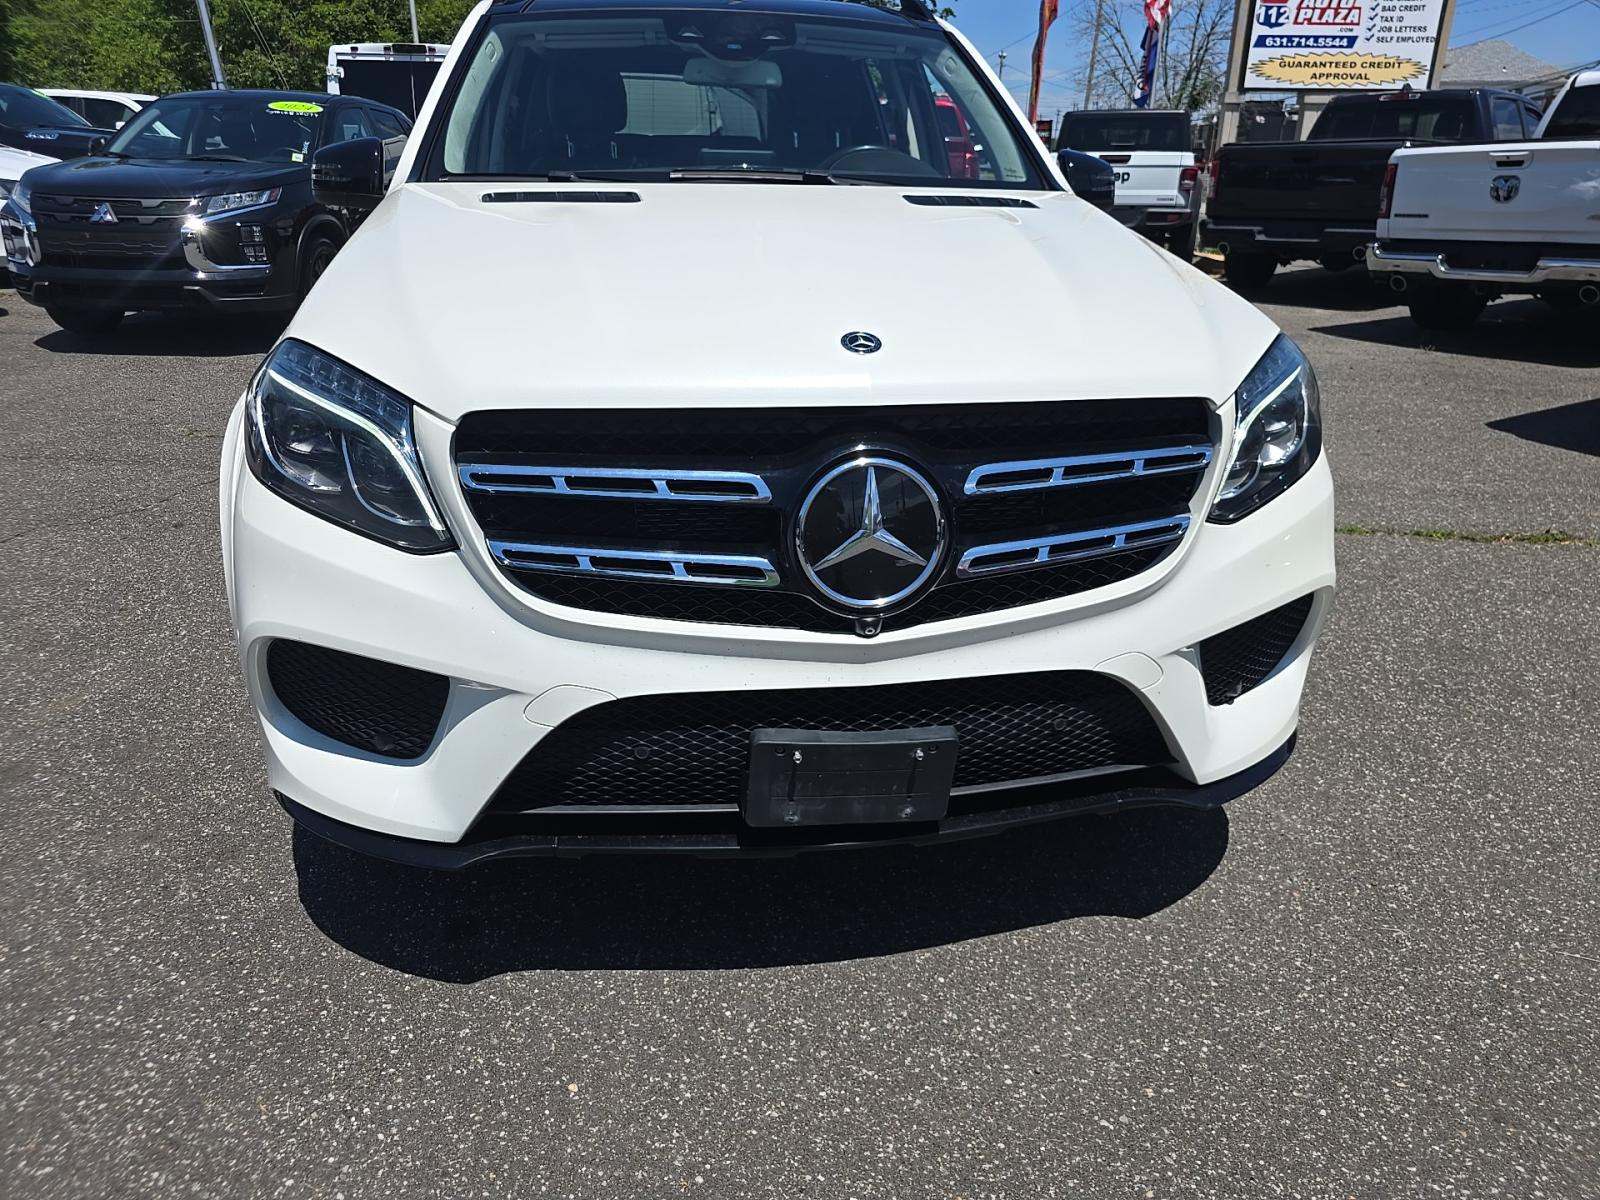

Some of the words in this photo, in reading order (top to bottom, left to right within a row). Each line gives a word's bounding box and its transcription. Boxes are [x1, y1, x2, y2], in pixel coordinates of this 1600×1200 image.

[1399, 4, 1426, 12] CREDIT
[1258, 6, 1290, 24] 112
[1297, 8, 1360, 23] PLAZA
[1394, 25, 1428, 33] LETTERS
[1265, 37, 1348, 47] 631.714.5544
[1279, 61, 1358, 69] GUARANTEED
[1360, 61, 1402, 69] CREDIT
[1113, 172, 1131, 184] ep
